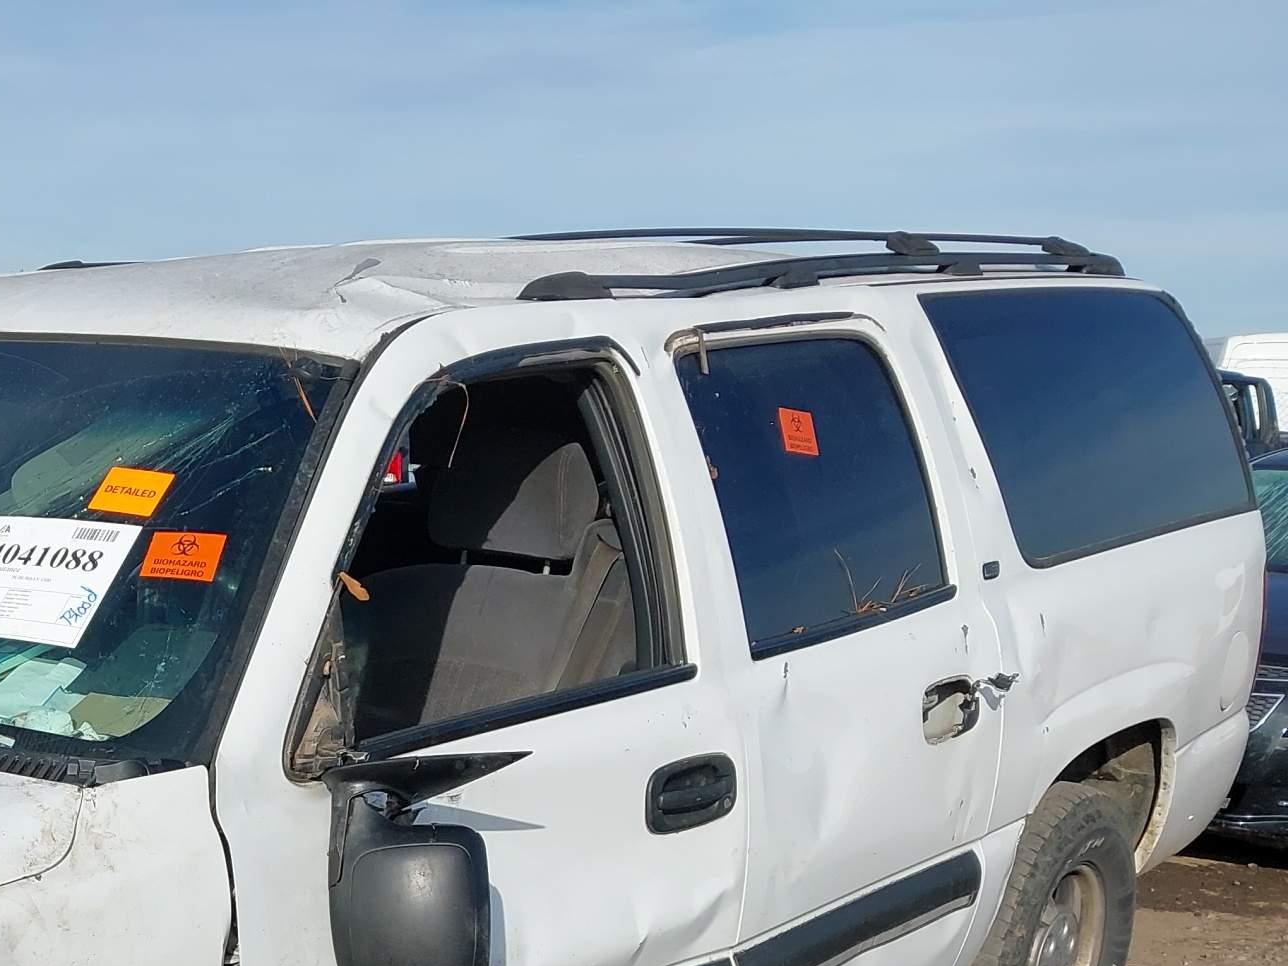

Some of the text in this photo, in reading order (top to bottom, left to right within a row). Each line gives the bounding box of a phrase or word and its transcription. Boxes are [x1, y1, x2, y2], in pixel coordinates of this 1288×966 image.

[104, 484, 157, 499] DETAILED
[153, 558, 207, 568] BIOHAZARD
[150, 567, 205, 578] BIOPELIGRO
